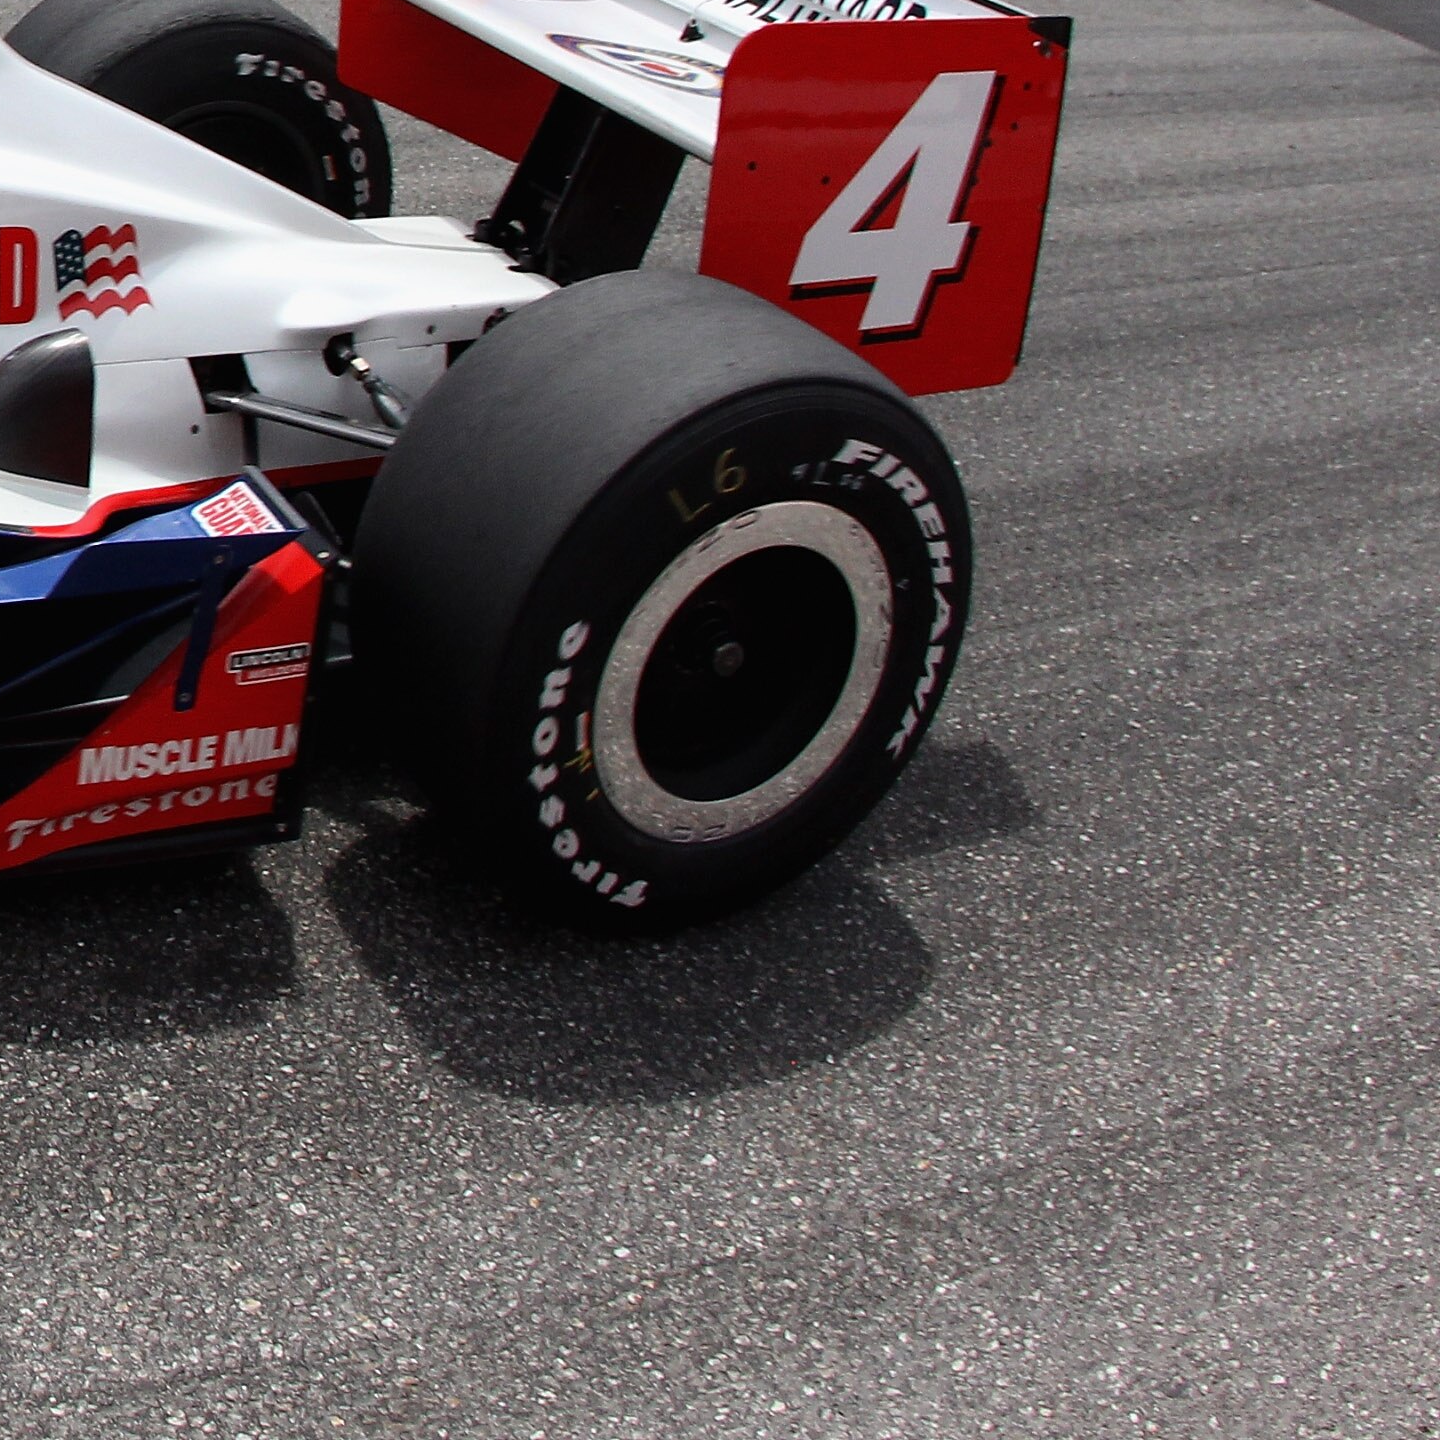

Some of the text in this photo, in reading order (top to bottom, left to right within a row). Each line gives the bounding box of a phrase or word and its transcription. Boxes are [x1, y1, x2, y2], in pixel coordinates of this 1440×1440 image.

[235, 53, 370, 218] Fireston
[788, 71, 1000, 334] 4
[829, 438, 954, 756] FIREHAWK
[5, 773, 278, 852] Firestone
[77, 736, 217, 786] MUSCLE
[528, 620, 650, 909] Firestone
